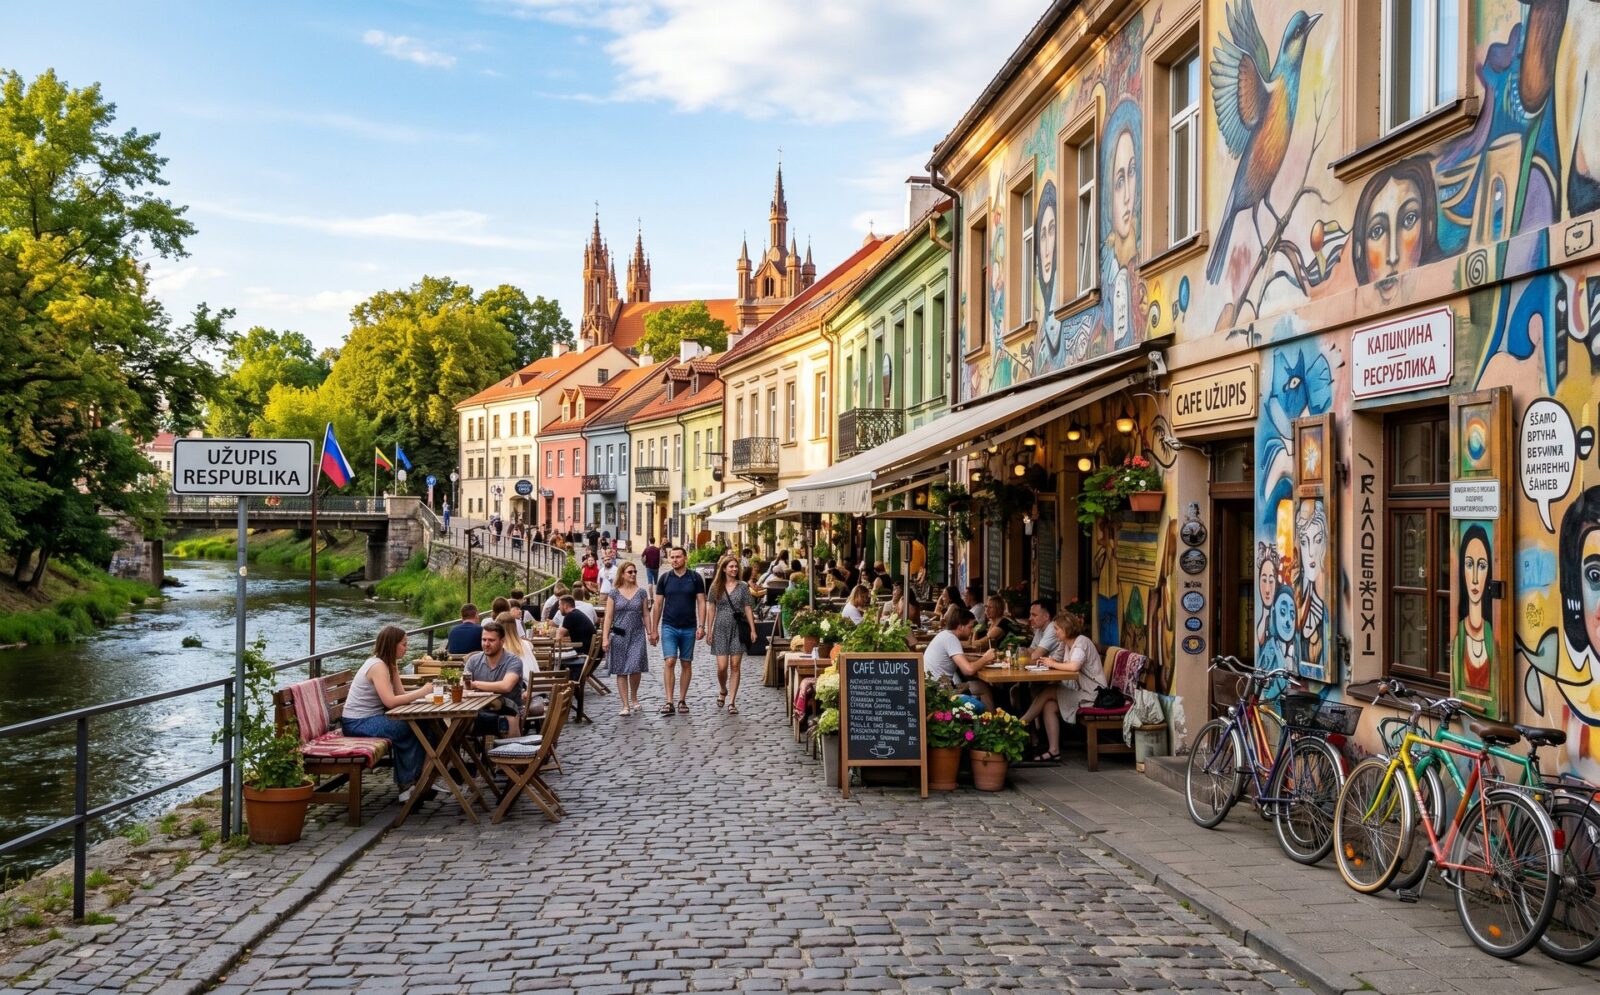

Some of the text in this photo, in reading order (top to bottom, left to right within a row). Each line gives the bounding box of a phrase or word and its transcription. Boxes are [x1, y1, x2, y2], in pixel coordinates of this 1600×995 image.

[1176, 381, 1247, 416] CAFE UŽUPIS
[208, 446, 277, 465] UŽUPIS
[183, 469, 301, 485] RESPUBLIKA
[852, 660, 910, 675] CAFÉ UŽUPIS
